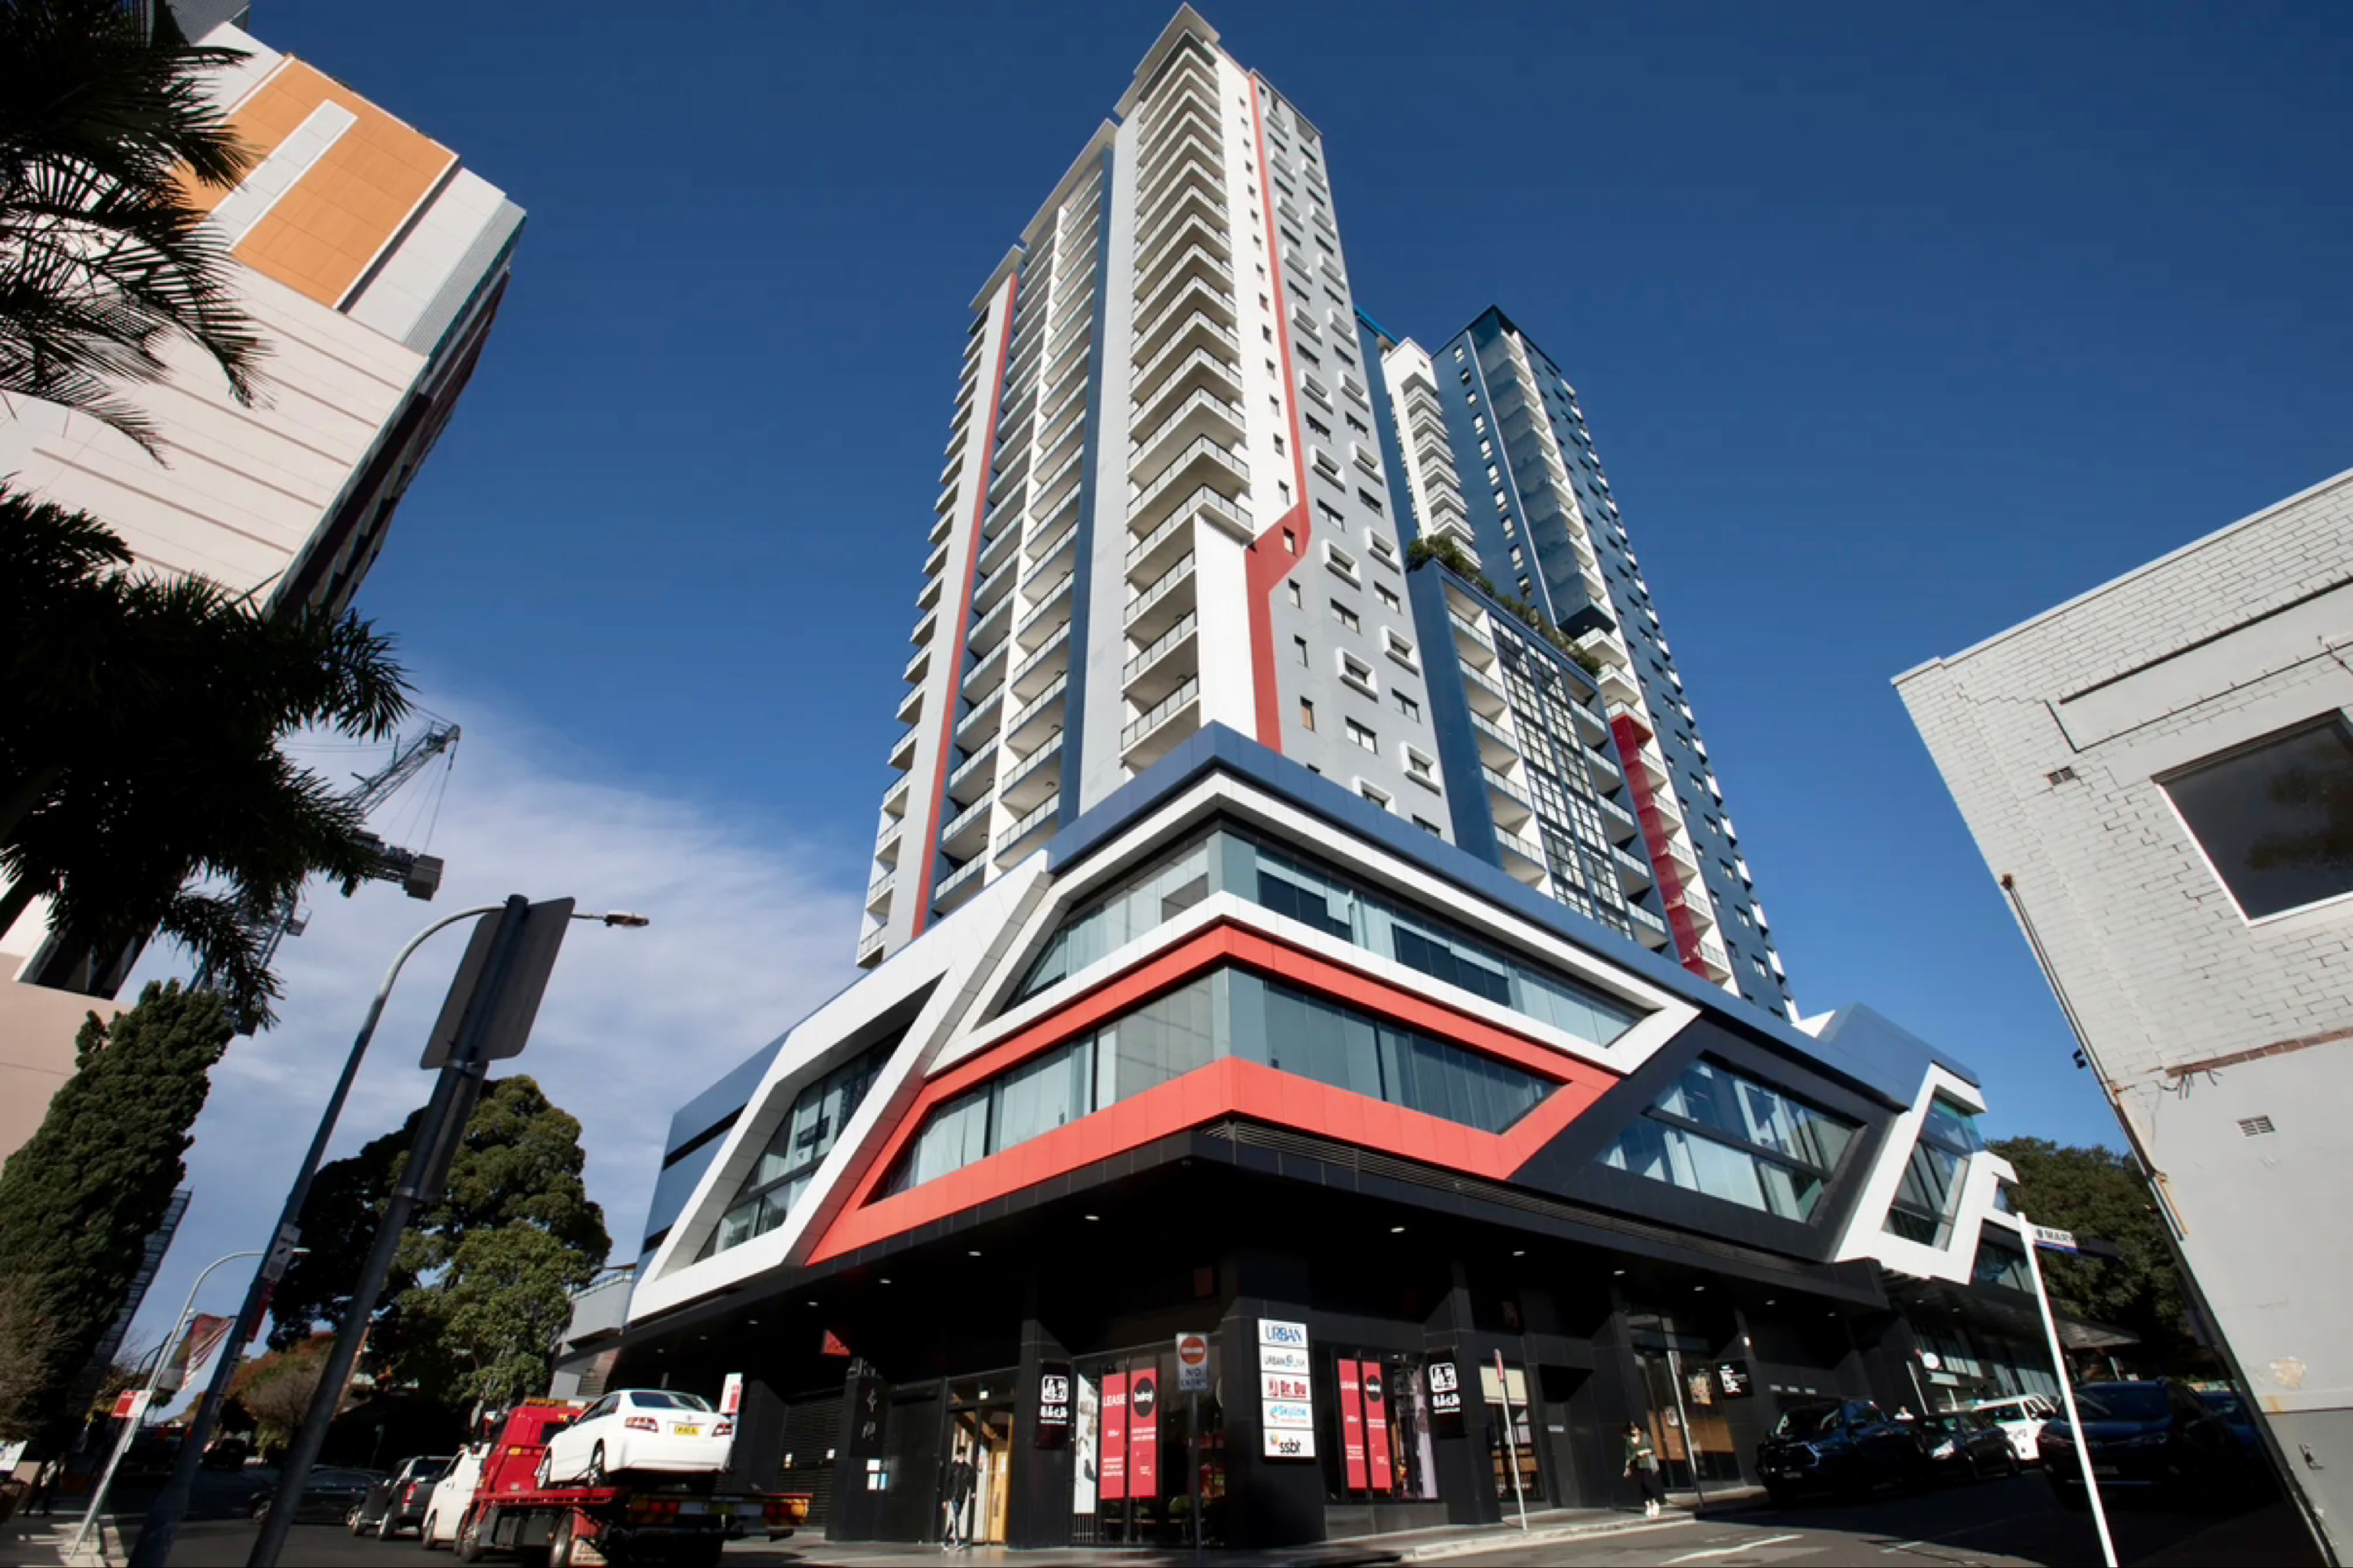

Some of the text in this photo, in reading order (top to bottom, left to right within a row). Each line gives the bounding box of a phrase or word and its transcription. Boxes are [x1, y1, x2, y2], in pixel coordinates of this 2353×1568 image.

[1265, 1325, 1302, 1342] URBAN
[1185, 1367, 1202, 1377] NO
[1103, 1393, 1127, 1406] LEASE
